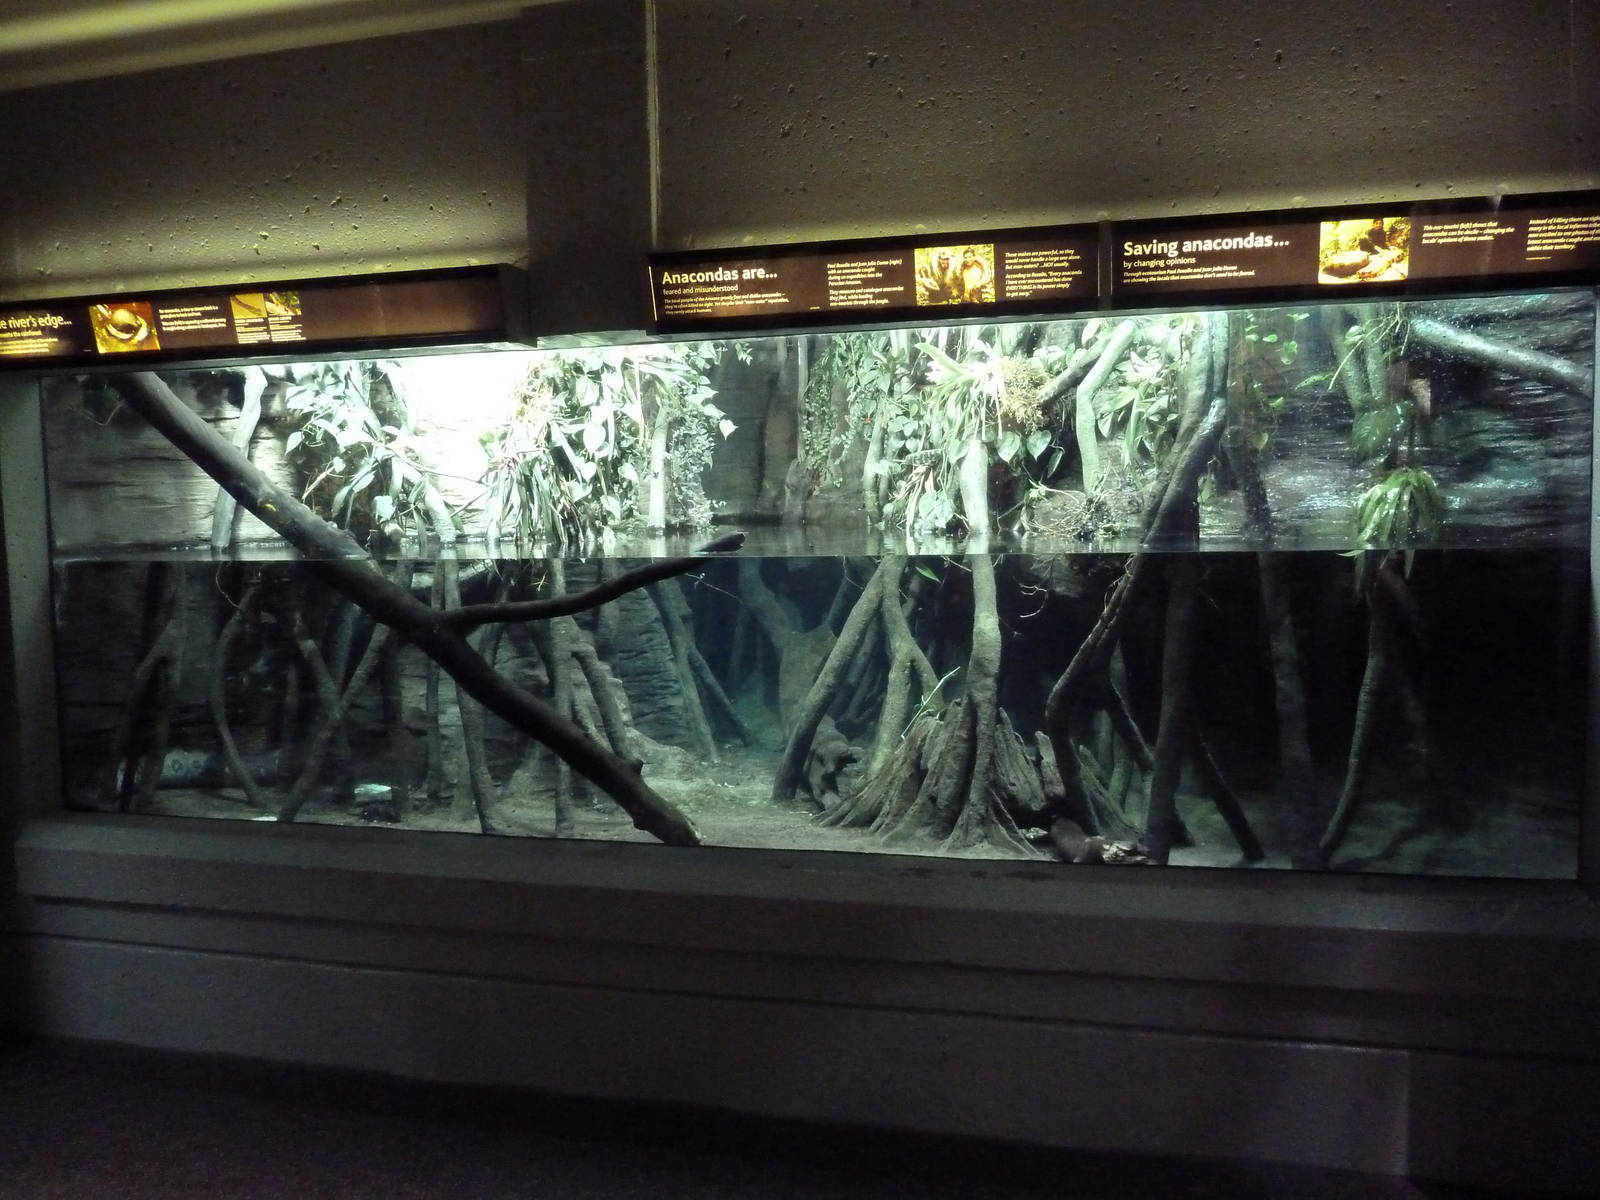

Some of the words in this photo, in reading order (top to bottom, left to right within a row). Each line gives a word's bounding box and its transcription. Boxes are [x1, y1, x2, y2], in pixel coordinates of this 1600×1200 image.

[1124, 240, 1178, 257] Saving
[1182, 232, 1289, 253] anacondas...
[1124, 261, 1132, 269] by
[1134, 258, 1165, 268] changing
[1166, 256, 1196, 266] opinions
[662, 267, 739, 284] Anacondas
[742, 268, 778, 280] are...
[695, 284, 738, 292] misunderstood
[9, 316, 38, 328] river's
[38, 314, 72, 328] edge...
